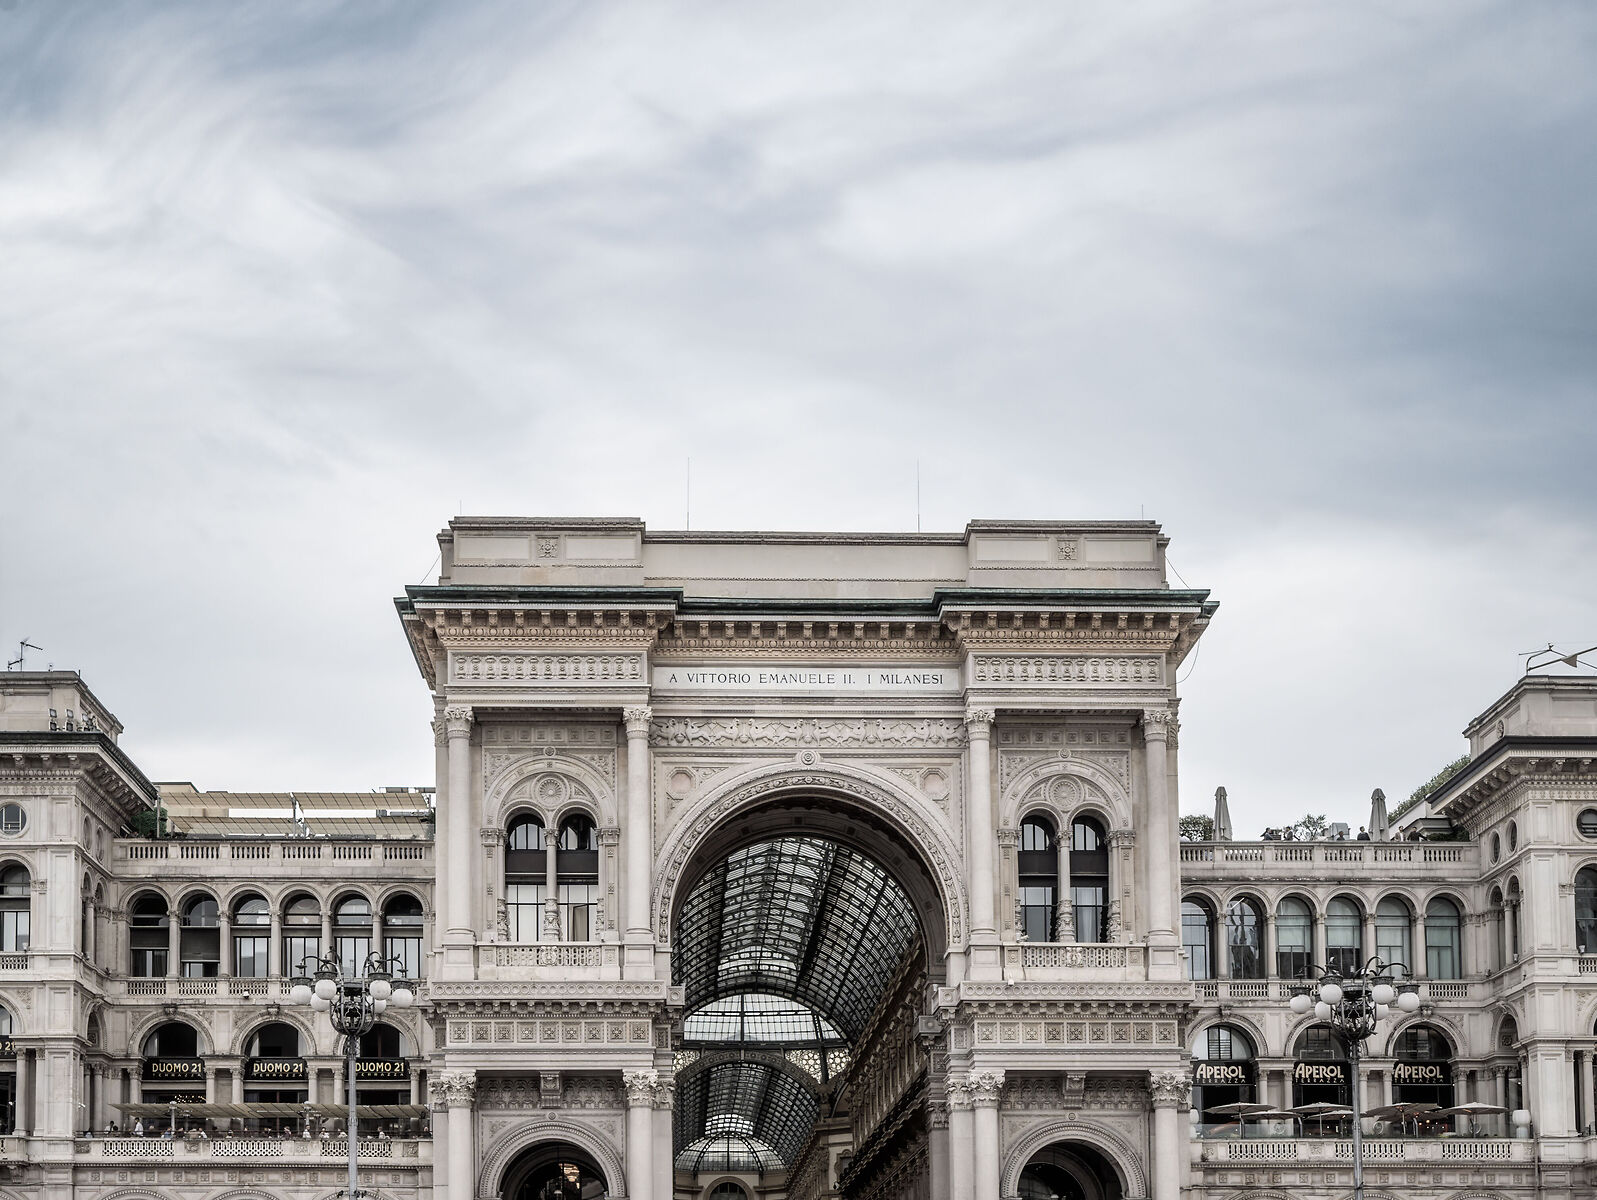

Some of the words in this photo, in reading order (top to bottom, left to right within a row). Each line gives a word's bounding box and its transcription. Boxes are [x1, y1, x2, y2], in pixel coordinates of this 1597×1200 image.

[669, 674, 678, 683] A
[687, 673, 751, 684] VITTORIO
[759, 674, 836, 684] EMANUELE
[879, 674, 944, 685] MILANESI
[152, 1063, 189, 1073] DUOMO
[191, 1063, 202, 1073] 21
[253, 1063, 290, 1073] DUOMO
[292, 1063, 303, 1073] 21
[355, 1062, 392, 1072] DUOMO
[394, 1062, 404, 1072] 21
[1196, 1063, 1246, 1079] APEROL
[1295, 1063, 1344, 1078] APEROL
[1394, 1063, 1443, 1078] APEROL
